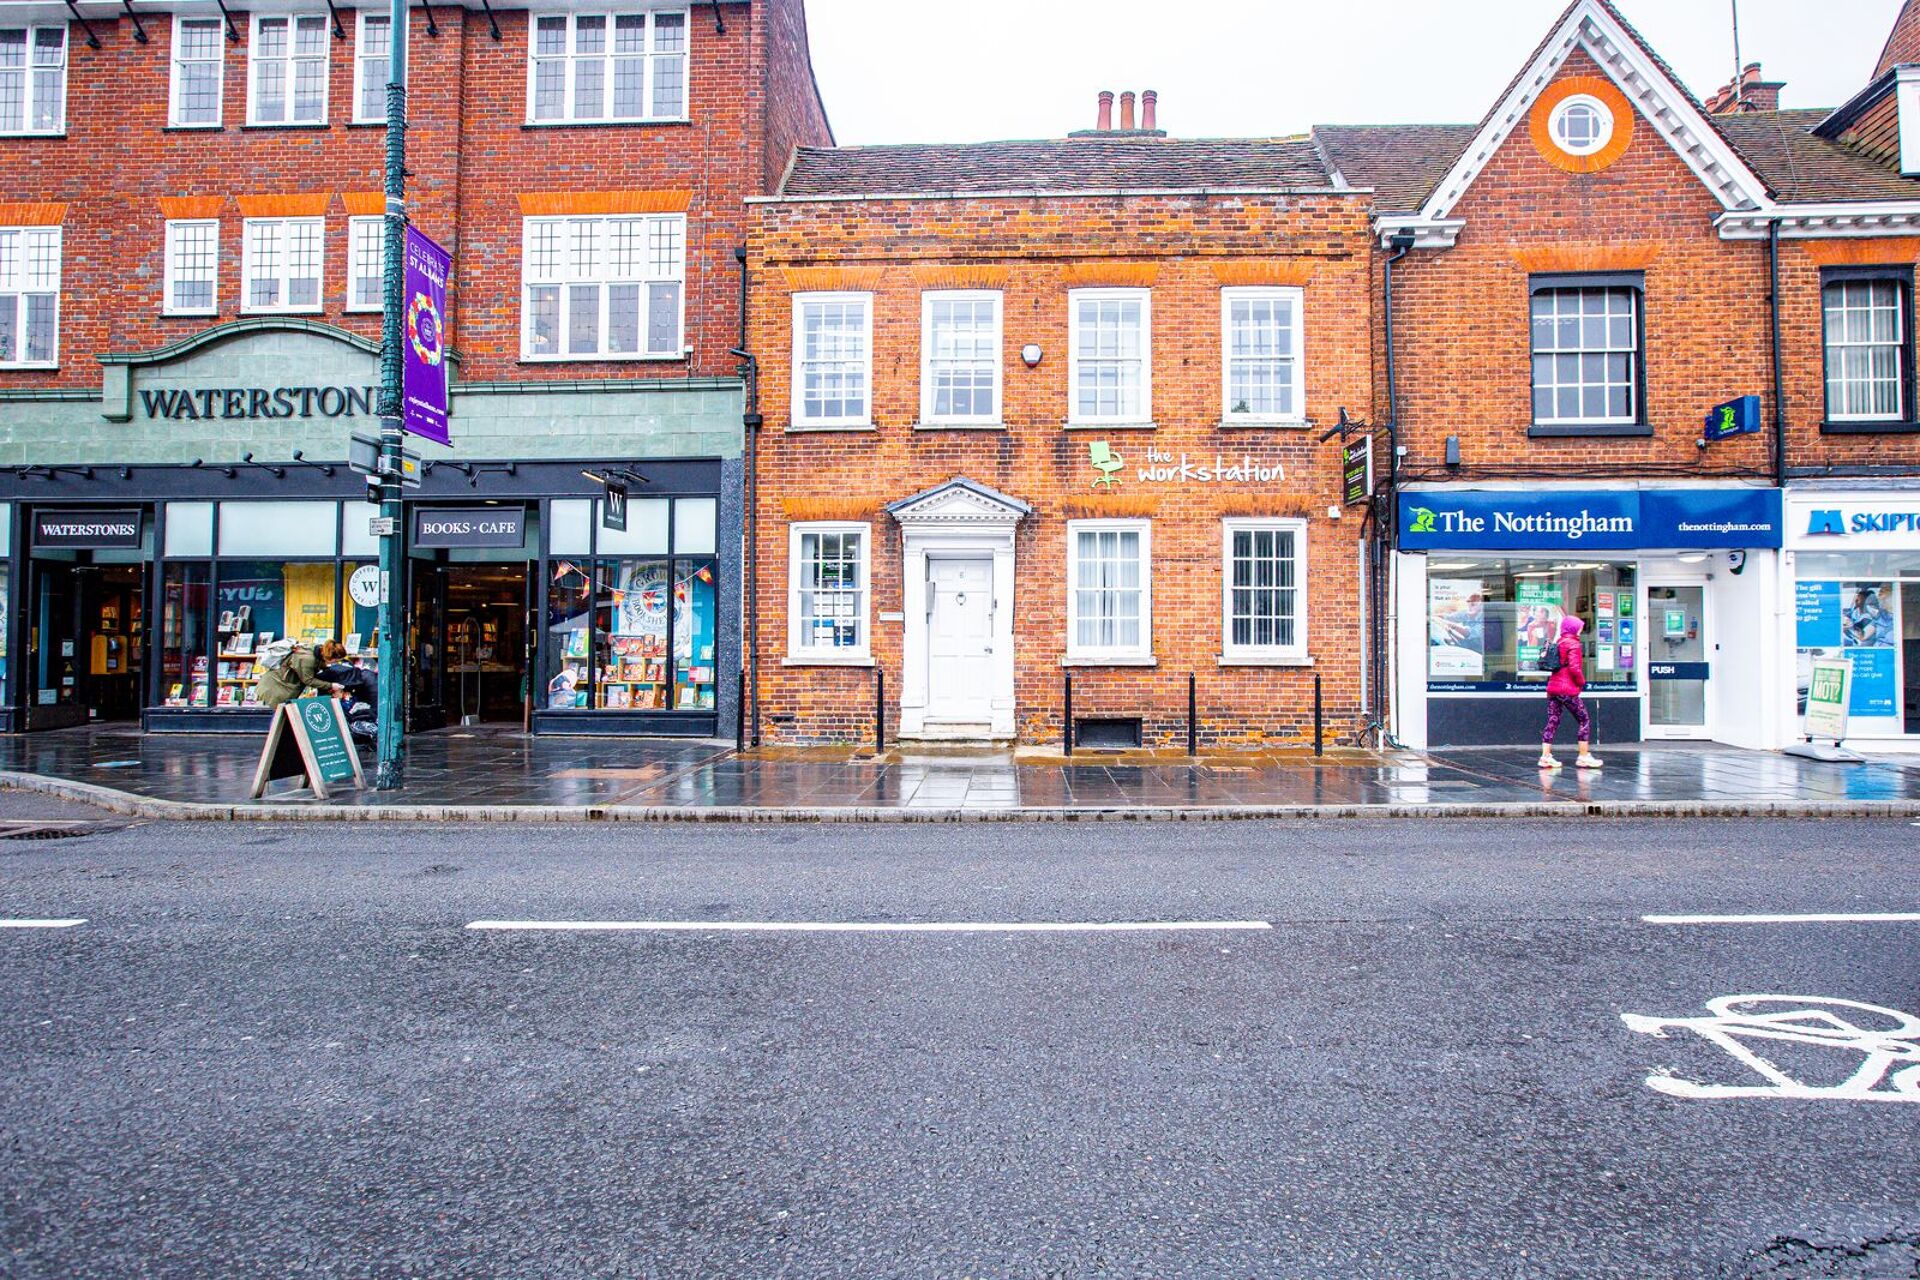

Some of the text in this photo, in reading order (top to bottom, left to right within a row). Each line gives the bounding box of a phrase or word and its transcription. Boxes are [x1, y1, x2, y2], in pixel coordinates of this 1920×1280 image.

[409, 255, 444, 289] ST ALBANS
[138, 386, 382, 419] WATERSTON
[1145, 446, 1174, 463] the
[1138, 453, 1286, 483] workstation
[608, 490, 623, 515] W
[42, 524, 135, 536] WATERSTONES
[422, 521, 516, 535] BOOKS CAFE
[1439, 509, 1634, 540] The Nottingham
[1678, 521, 1771, 534] thenottingham.com
[1851, 512, 1920, 533] SKIPT
[361, 580, 379, 593] W
[1651, 666, 1675, 674] PUSH
[1814, 680, 1842, 701] MOT?
